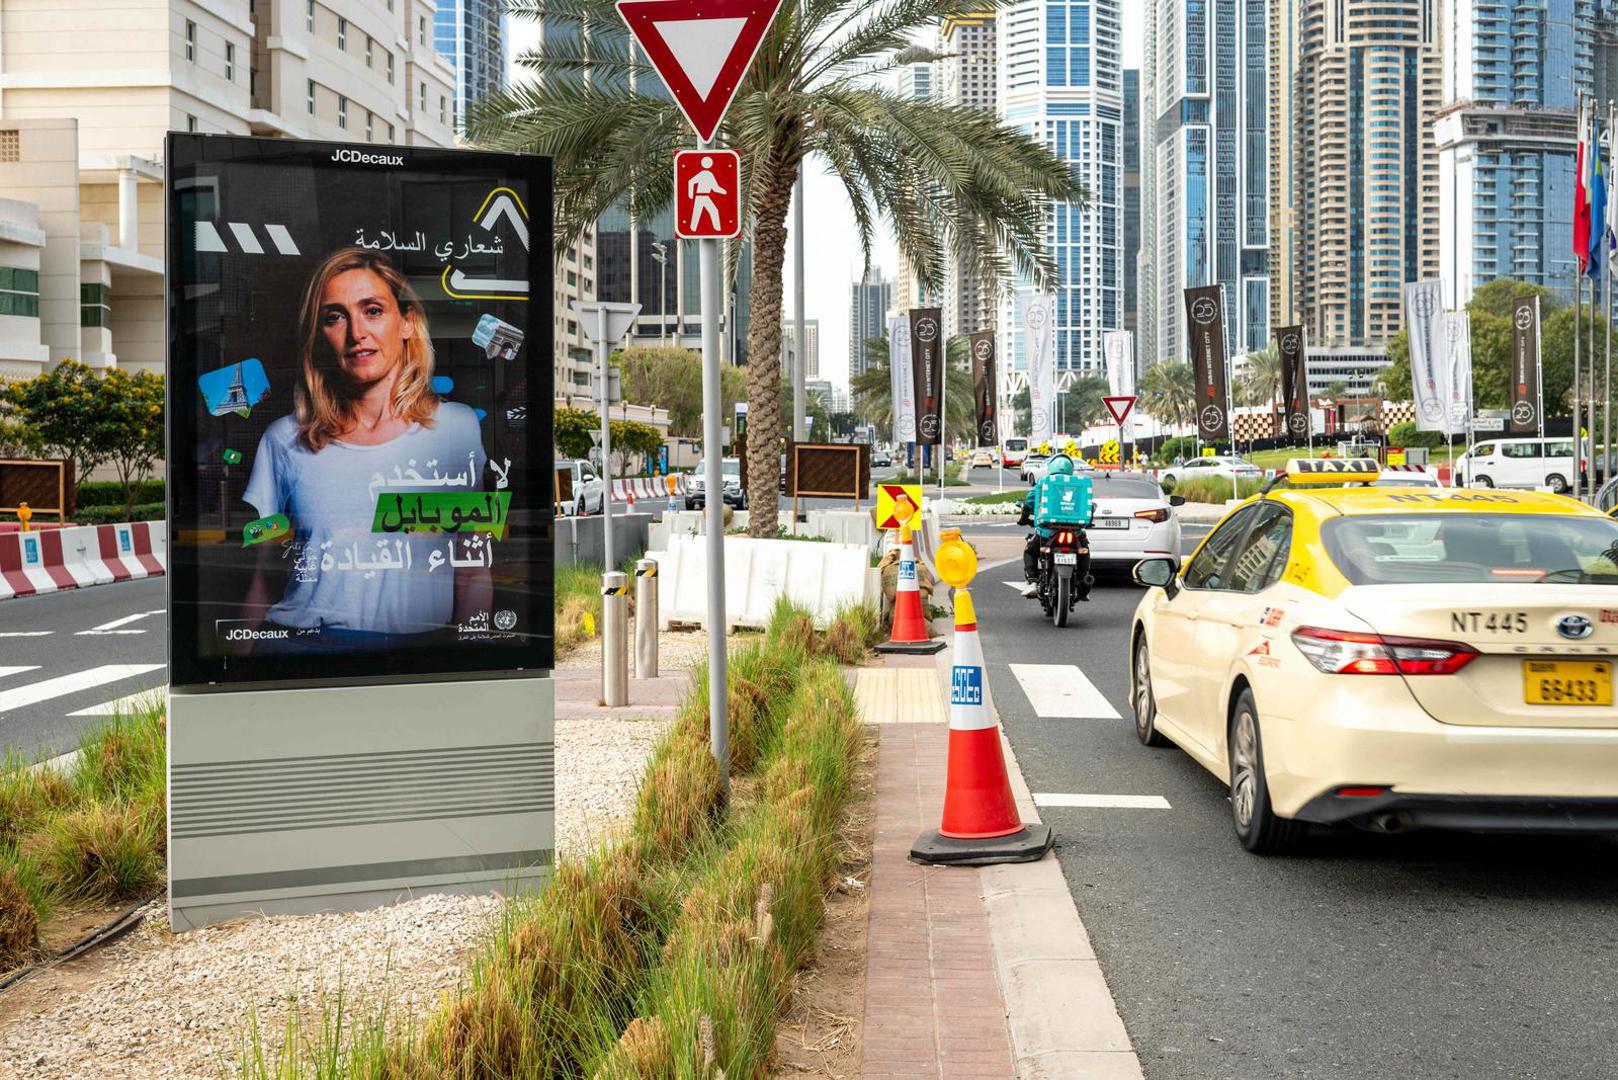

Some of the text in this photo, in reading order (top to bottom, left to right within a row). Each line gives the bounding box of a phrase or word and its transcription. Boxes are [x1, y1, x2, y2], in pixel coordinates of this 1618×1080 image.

[331, 149, 404, 167] JCDecaux
[355, 228, 504, 262] شعاري السلامة
[367, 451, 512, 502] لا أستخدم
[1306, 460, 1368, 472] TAXI
[381, 493, 502, 534] الموبايل
[320, 539, 412, 580] القيادة
[428, 531, 493, 573] أثناء
[226, 629, 289, 641] JCDecaux
